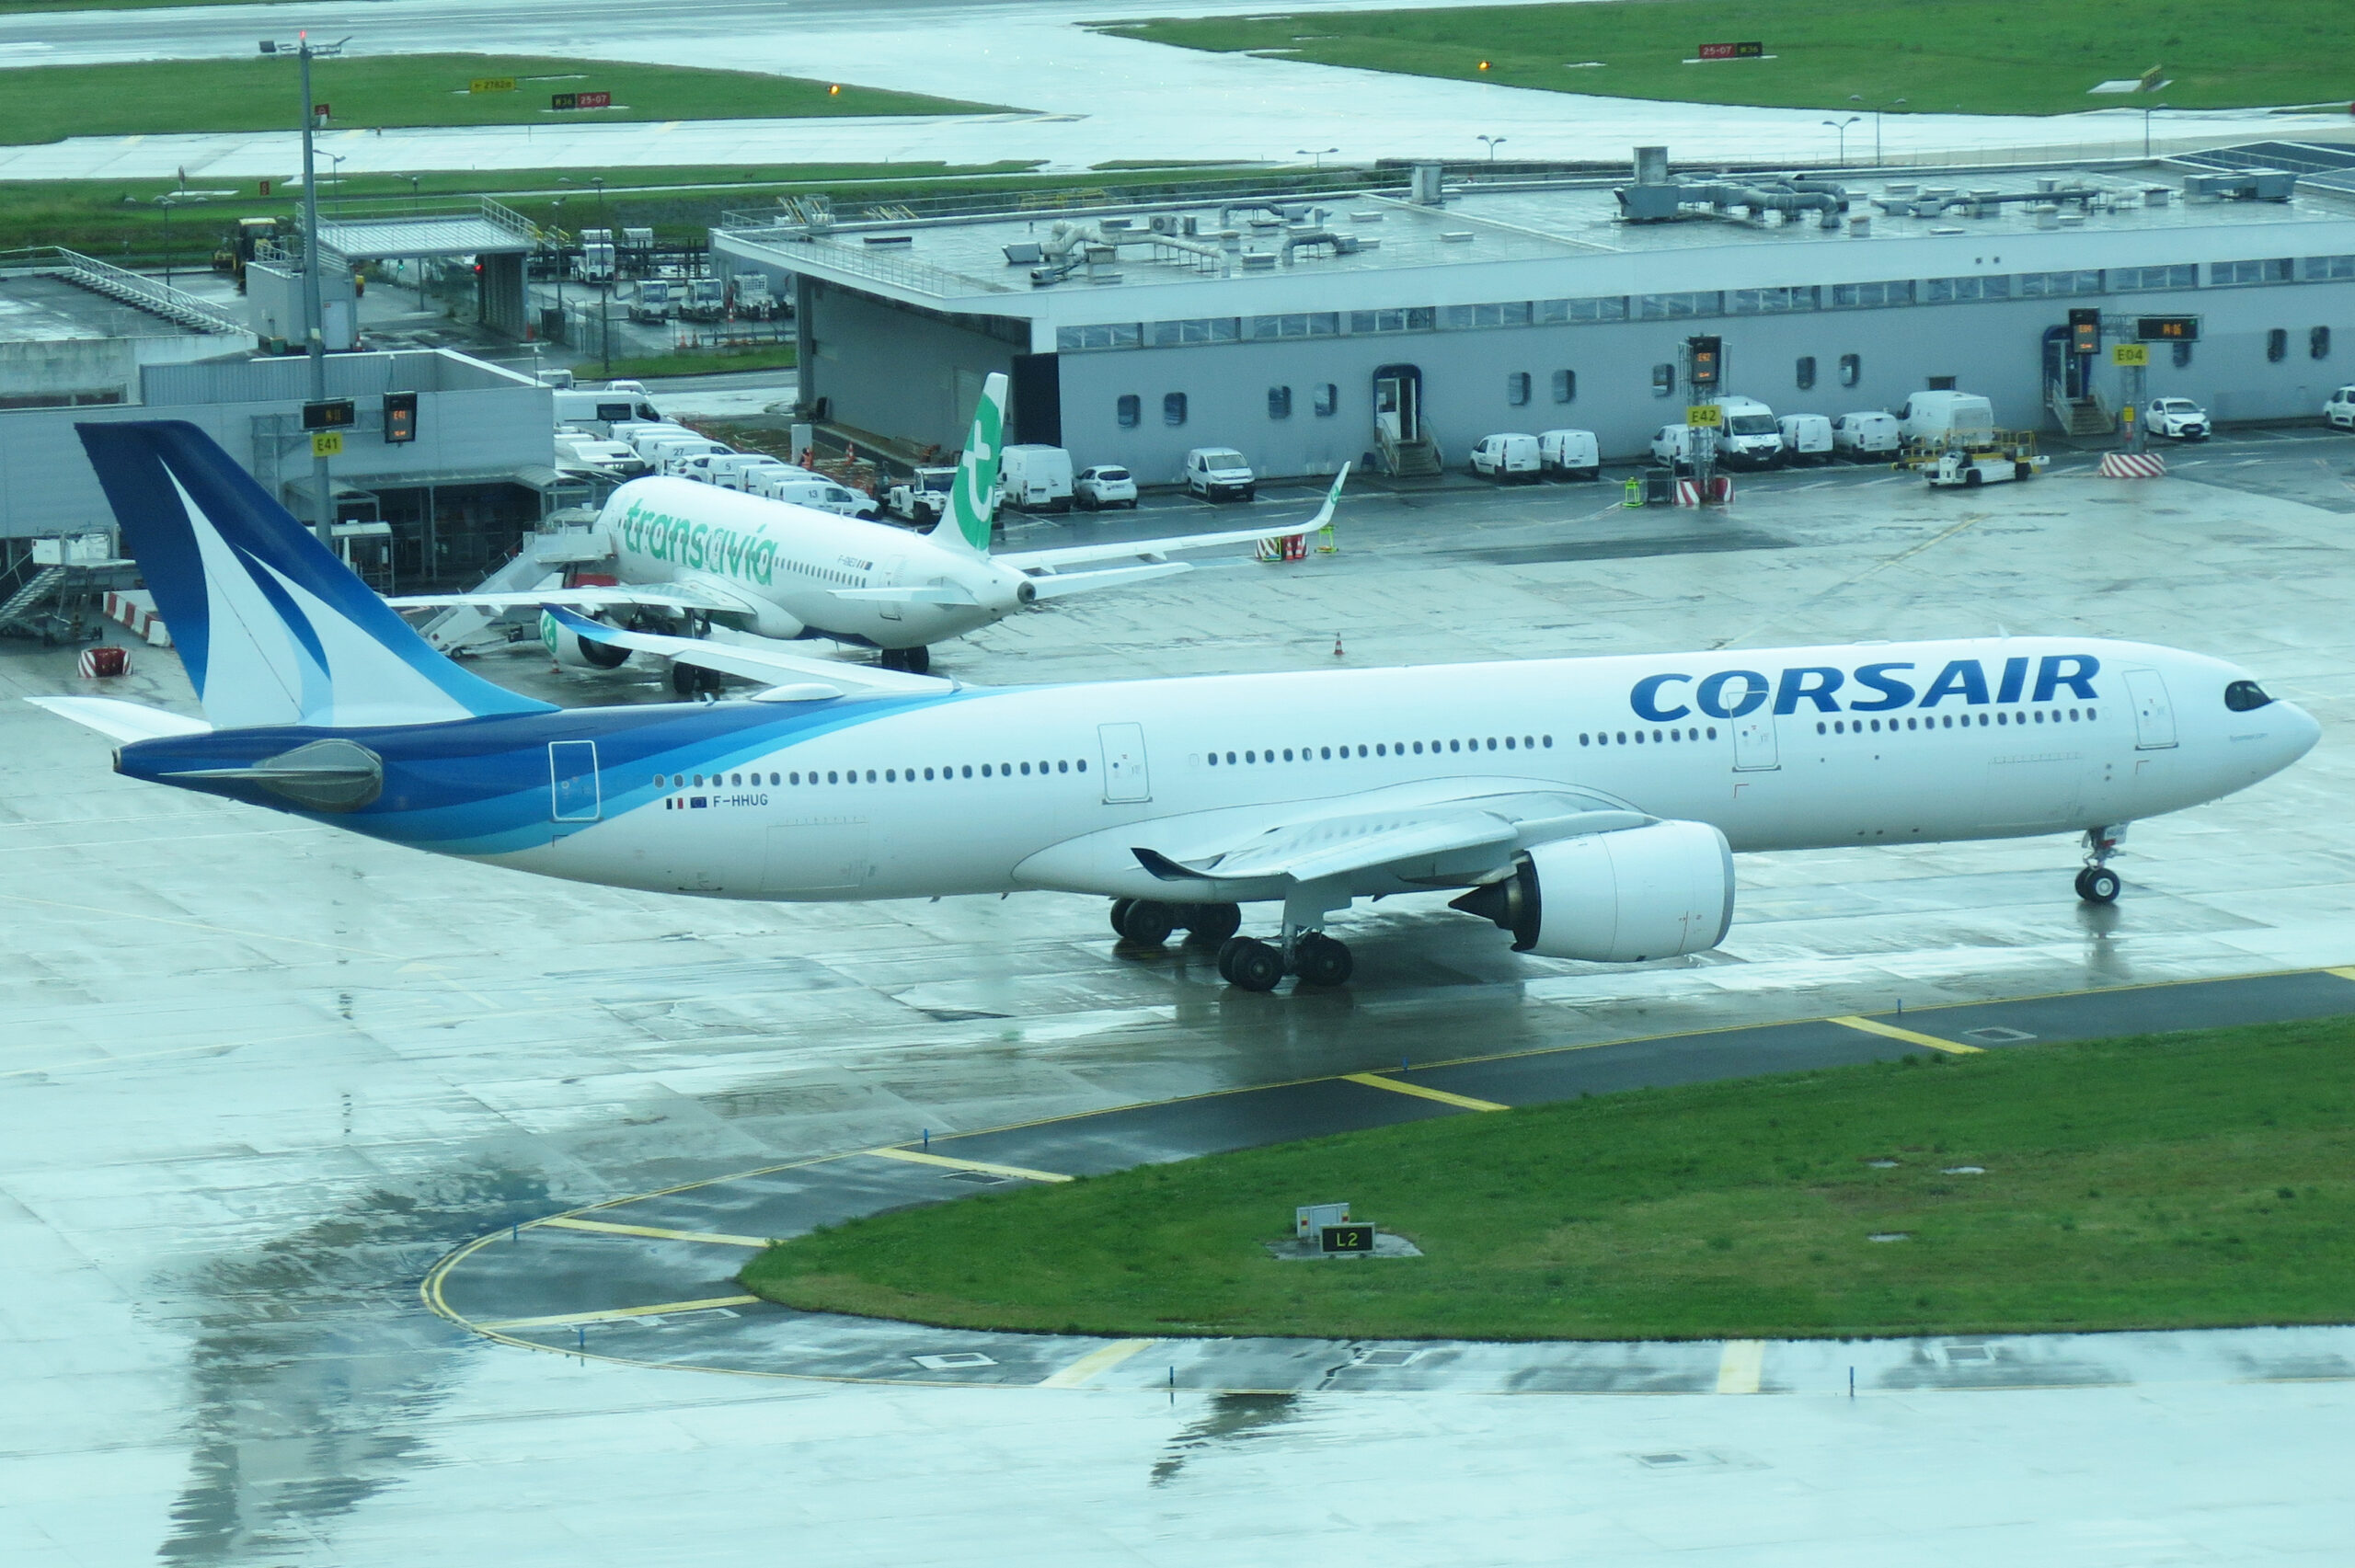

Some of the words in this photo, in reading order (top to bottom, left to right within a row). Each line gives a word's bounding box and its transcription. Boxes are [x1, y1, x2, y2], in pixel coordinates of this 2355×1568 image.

[1703, 45, 1733, 56] 25-07
[580, 94, 608, 106] 25-07
[2117, 349, 2143, 361] E04
[1692, 409, 1717, 423] E42
[316, 438, 339, 452] E41
[673, 447, 685, 456] 27
[809, 489, 819, 498] 13
[620, 498, 779, 587] transavia
[1629, 653, 2101, 723] CORSAIR
[713, 794, 769, 808] F-HHUG
[1336, 1231, 1359, 1248] L2
